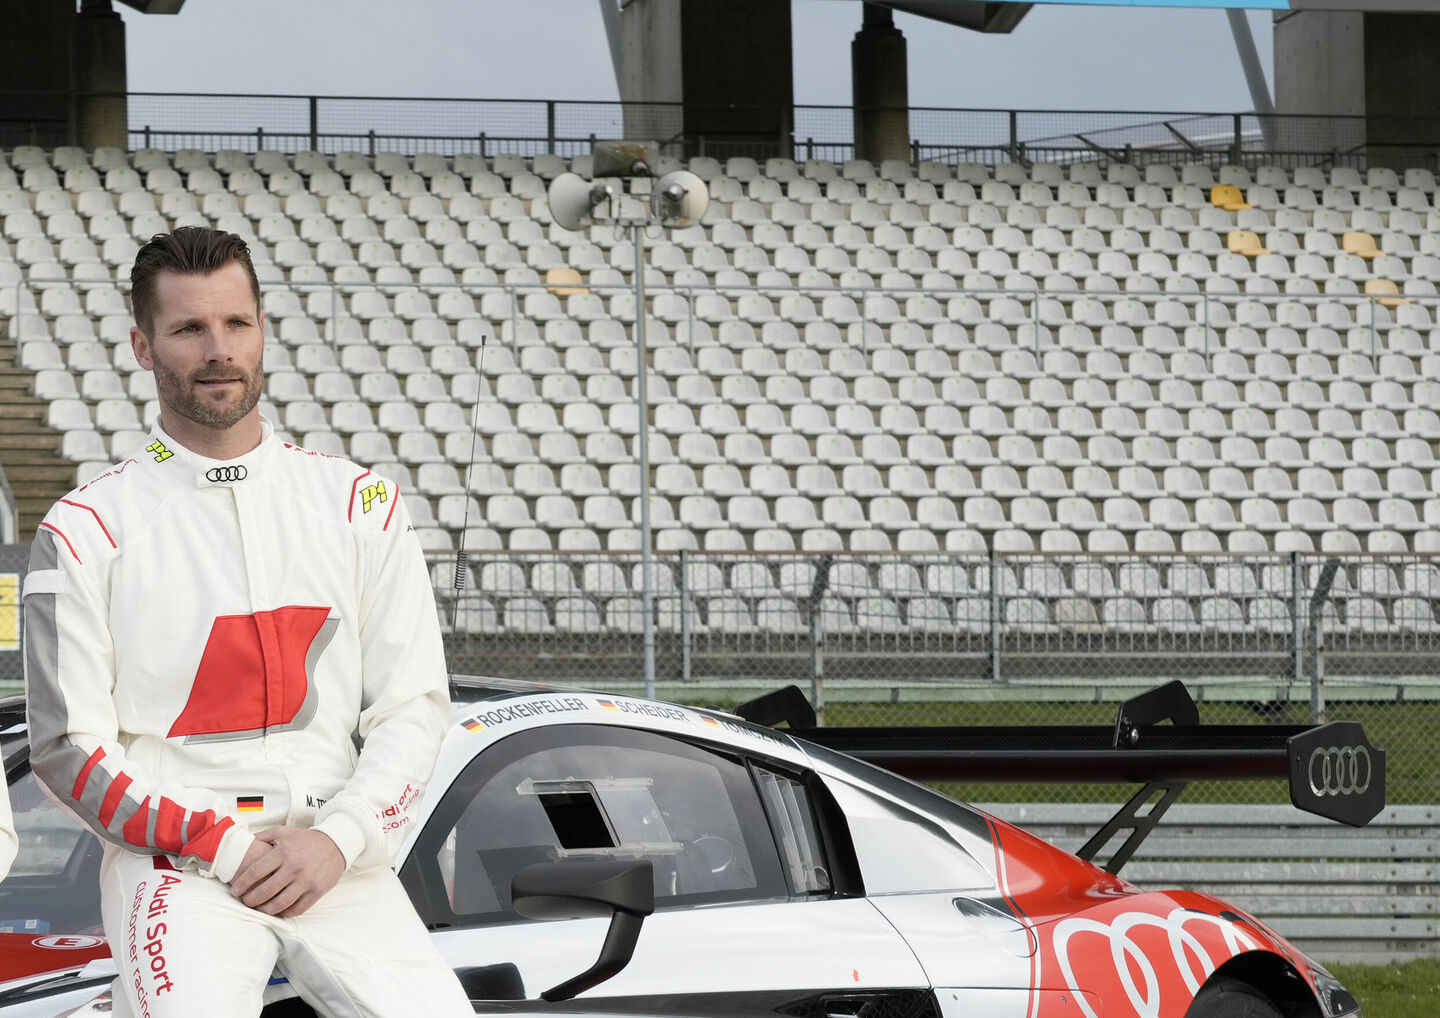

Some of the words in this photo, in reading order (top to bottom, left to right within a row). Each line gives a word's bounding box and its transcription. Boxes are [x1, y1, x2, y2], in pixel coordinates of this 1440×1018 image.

[145, 438, 174, 463] P1
[359, 480, 388, 513] P1
[477, 697, 589, 728] ROCKENFELLER
[613, 700, 691, 723] SCHEIDER
[147, 874, 182, 920] Audi
[128, 881, 147, 964] customer
[143, 922, 174, 997] Sport
